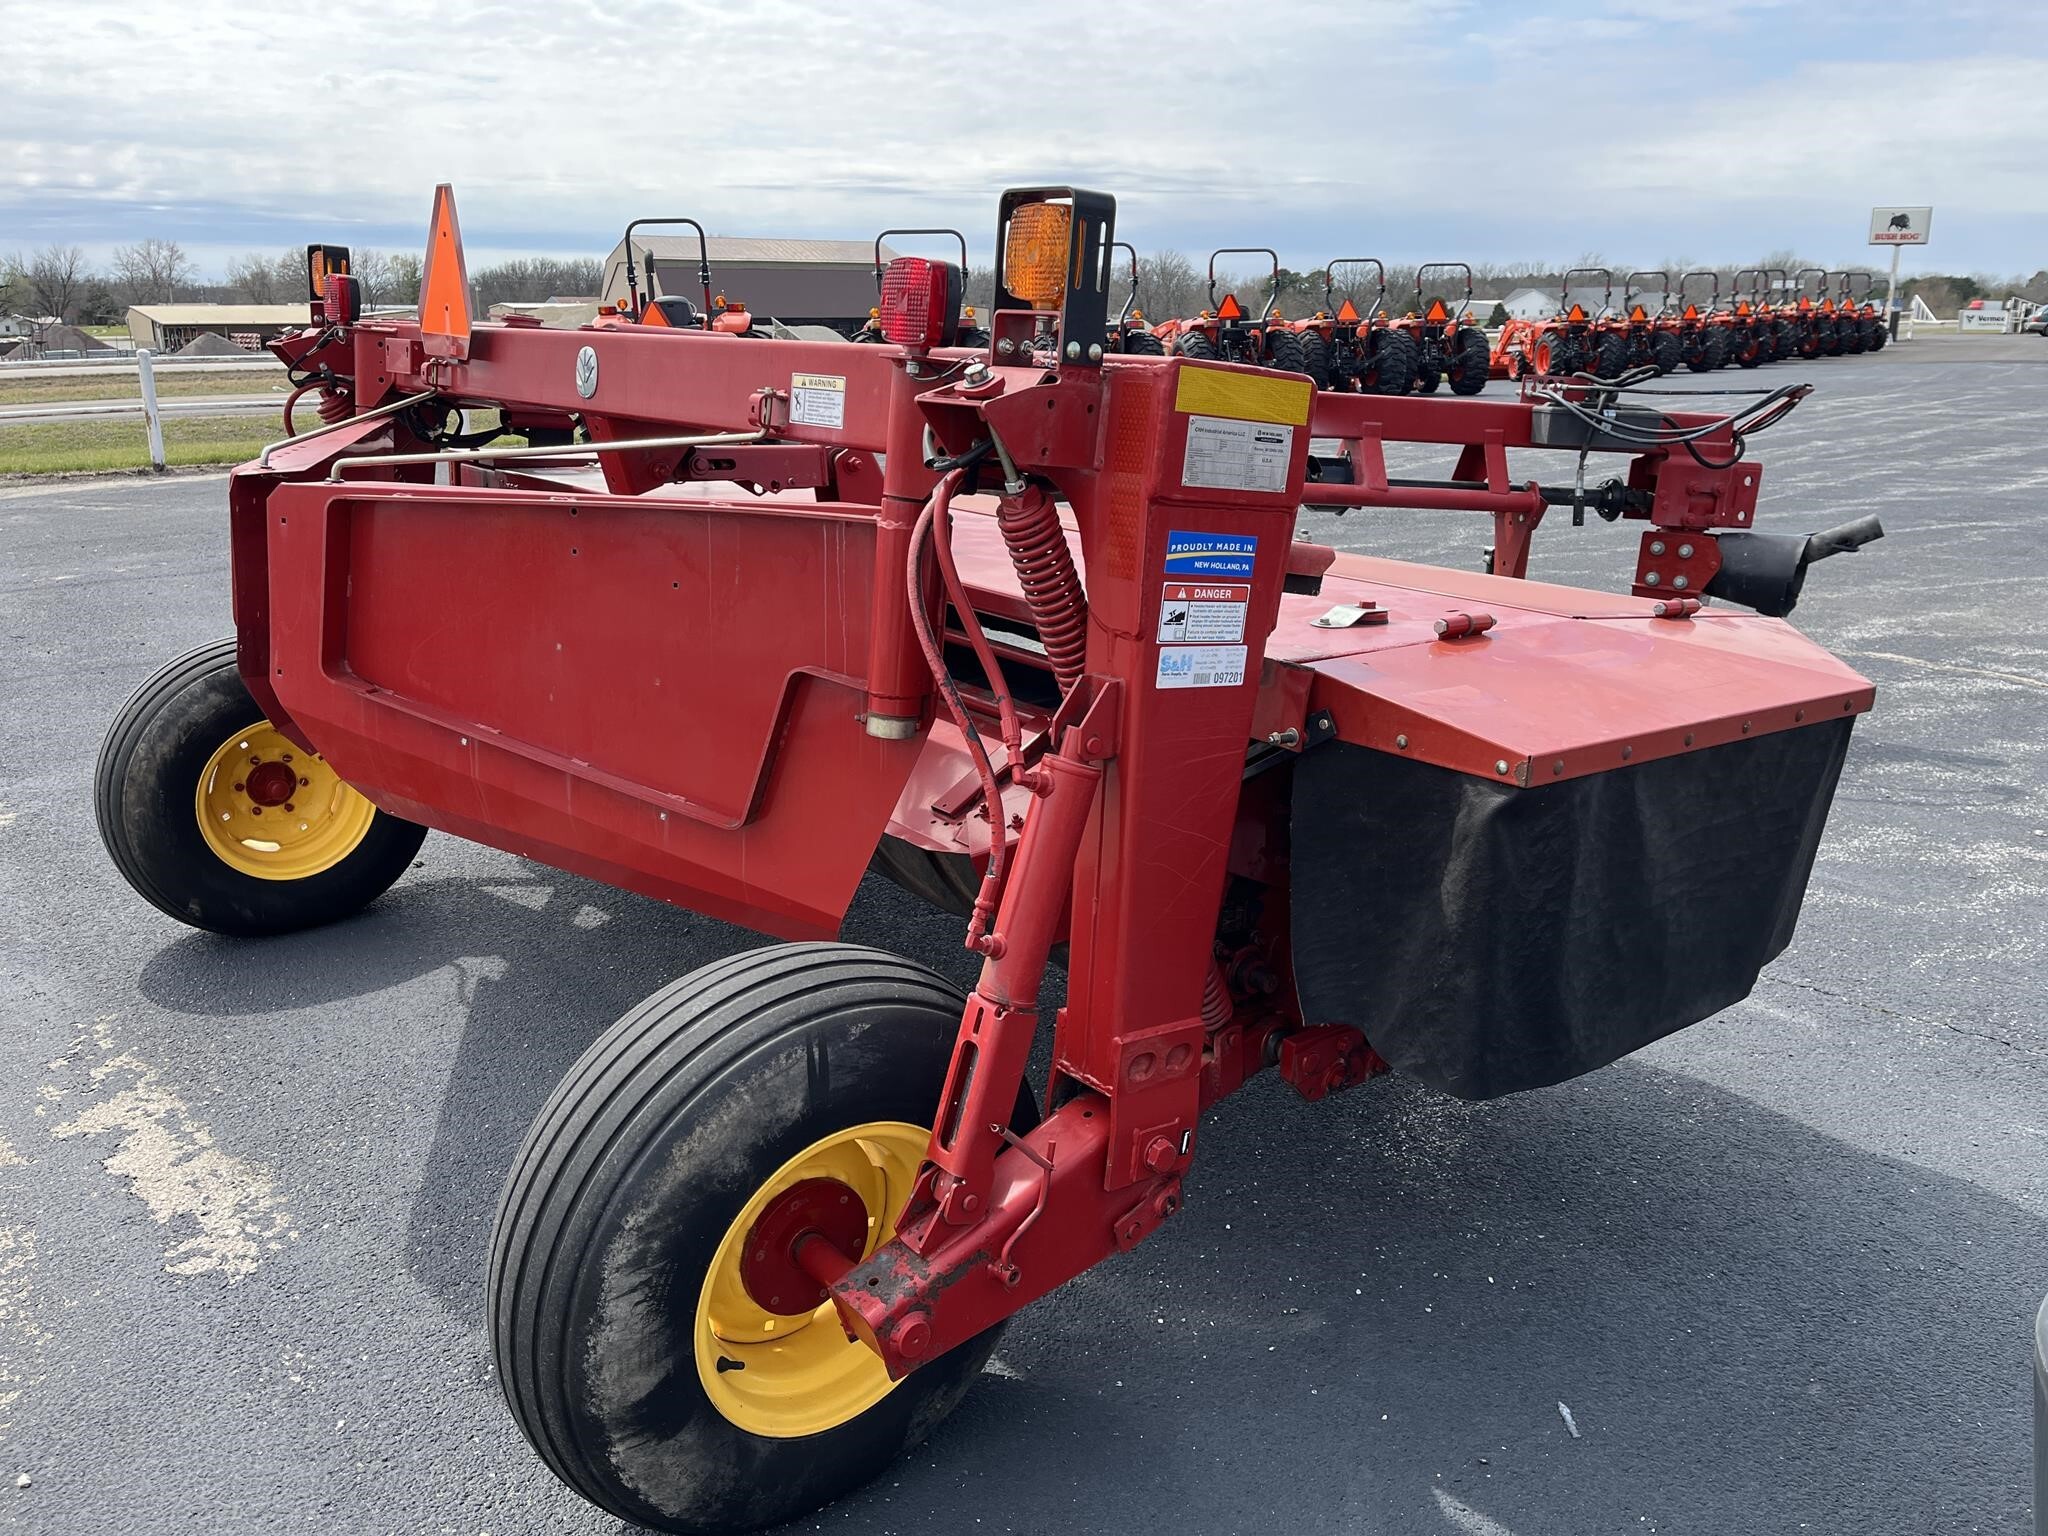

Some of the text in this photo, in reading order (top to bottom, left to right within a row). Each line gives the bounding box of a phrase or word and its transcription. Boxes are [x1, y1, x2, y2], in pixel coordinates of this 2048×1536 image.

[808, 379, 837, 388] WARNING
[1171, 543, 1213, 552] PROUDLY
[1216, 543, 1240, 551] MADE
[1210, 562, 1241, 571] HOLLAND,
[1194, 589, 1232, 599] DANGER
[1160, 654, 1193, 672] S&H
[1214, 672, 1243, 684] 097201
